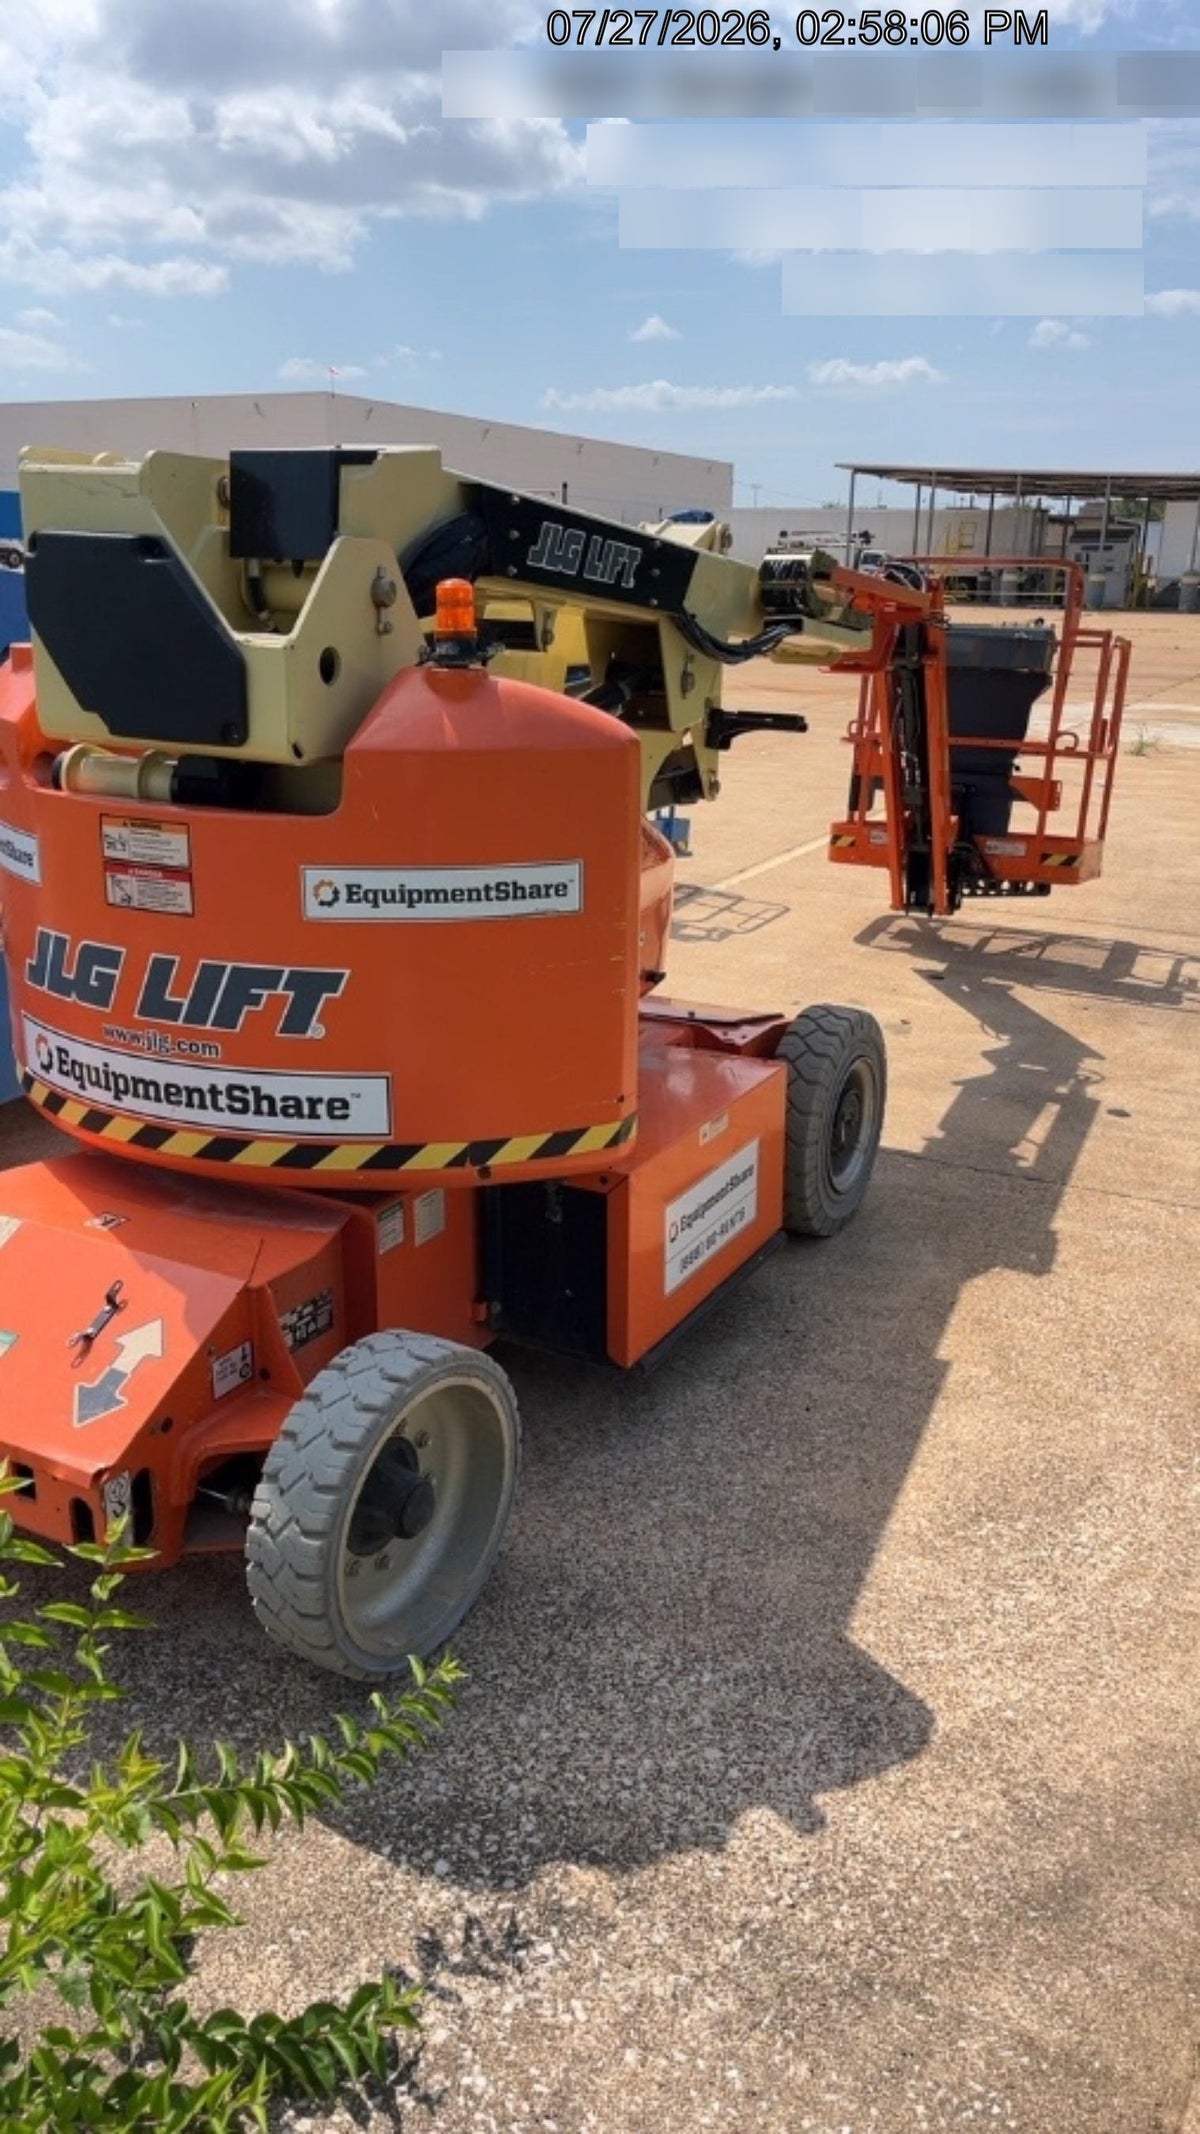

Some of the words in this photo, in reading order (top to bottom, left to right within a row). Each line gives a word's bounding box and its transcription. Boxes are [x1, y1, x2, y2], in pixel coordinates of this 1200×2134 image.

[526, 521, 586, 576] JLG
[583, 535, 642, 588] LIFT
[25, 926, 126, 1012] JLG
[103, 1024, 220, 1057] www.jlg.com
